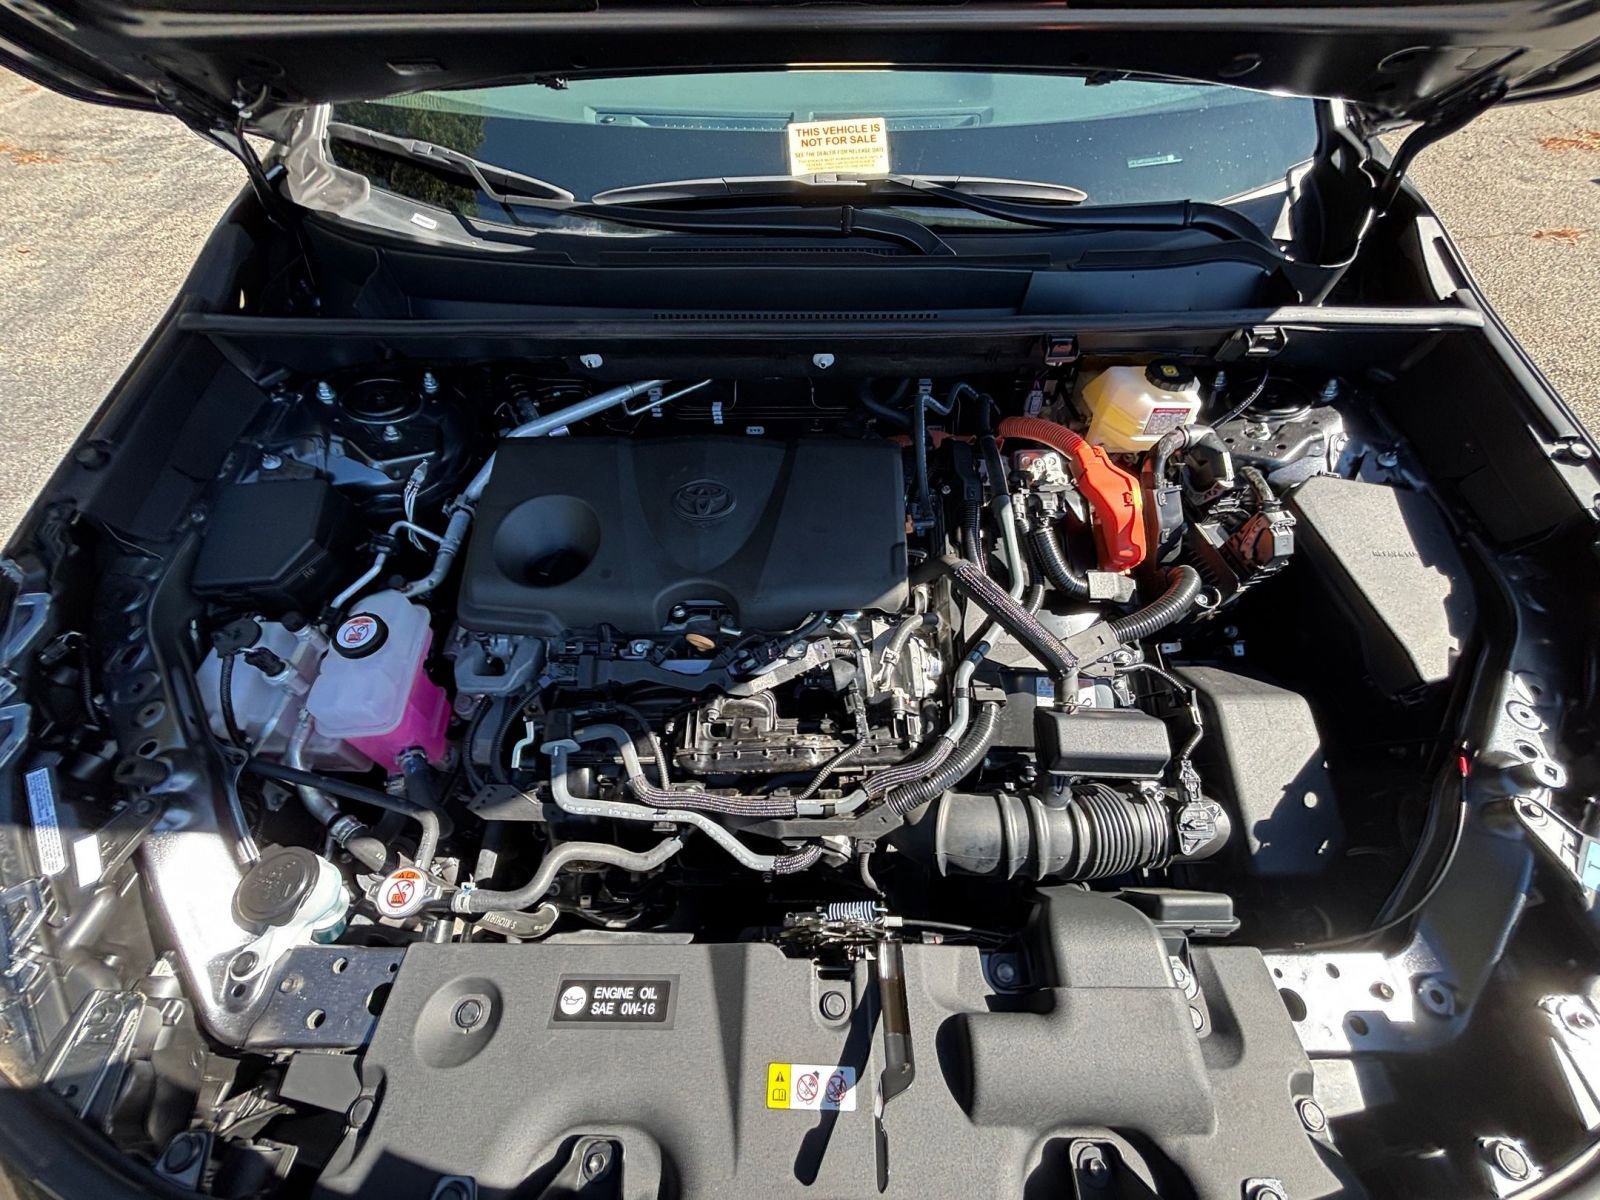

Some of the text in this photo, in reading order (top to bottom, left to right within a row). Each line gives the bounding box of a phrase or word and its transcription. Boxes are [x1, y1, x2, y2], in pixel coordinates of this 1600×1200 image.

[795, 123, 881, 137] THIS VEHICLE IS
[801, 134, 878, 148] NOT FOR SALE
[593, 986, 658, 999] ENGINE OIL
[590, 1002, 656, 1015] SAE 0W-16
